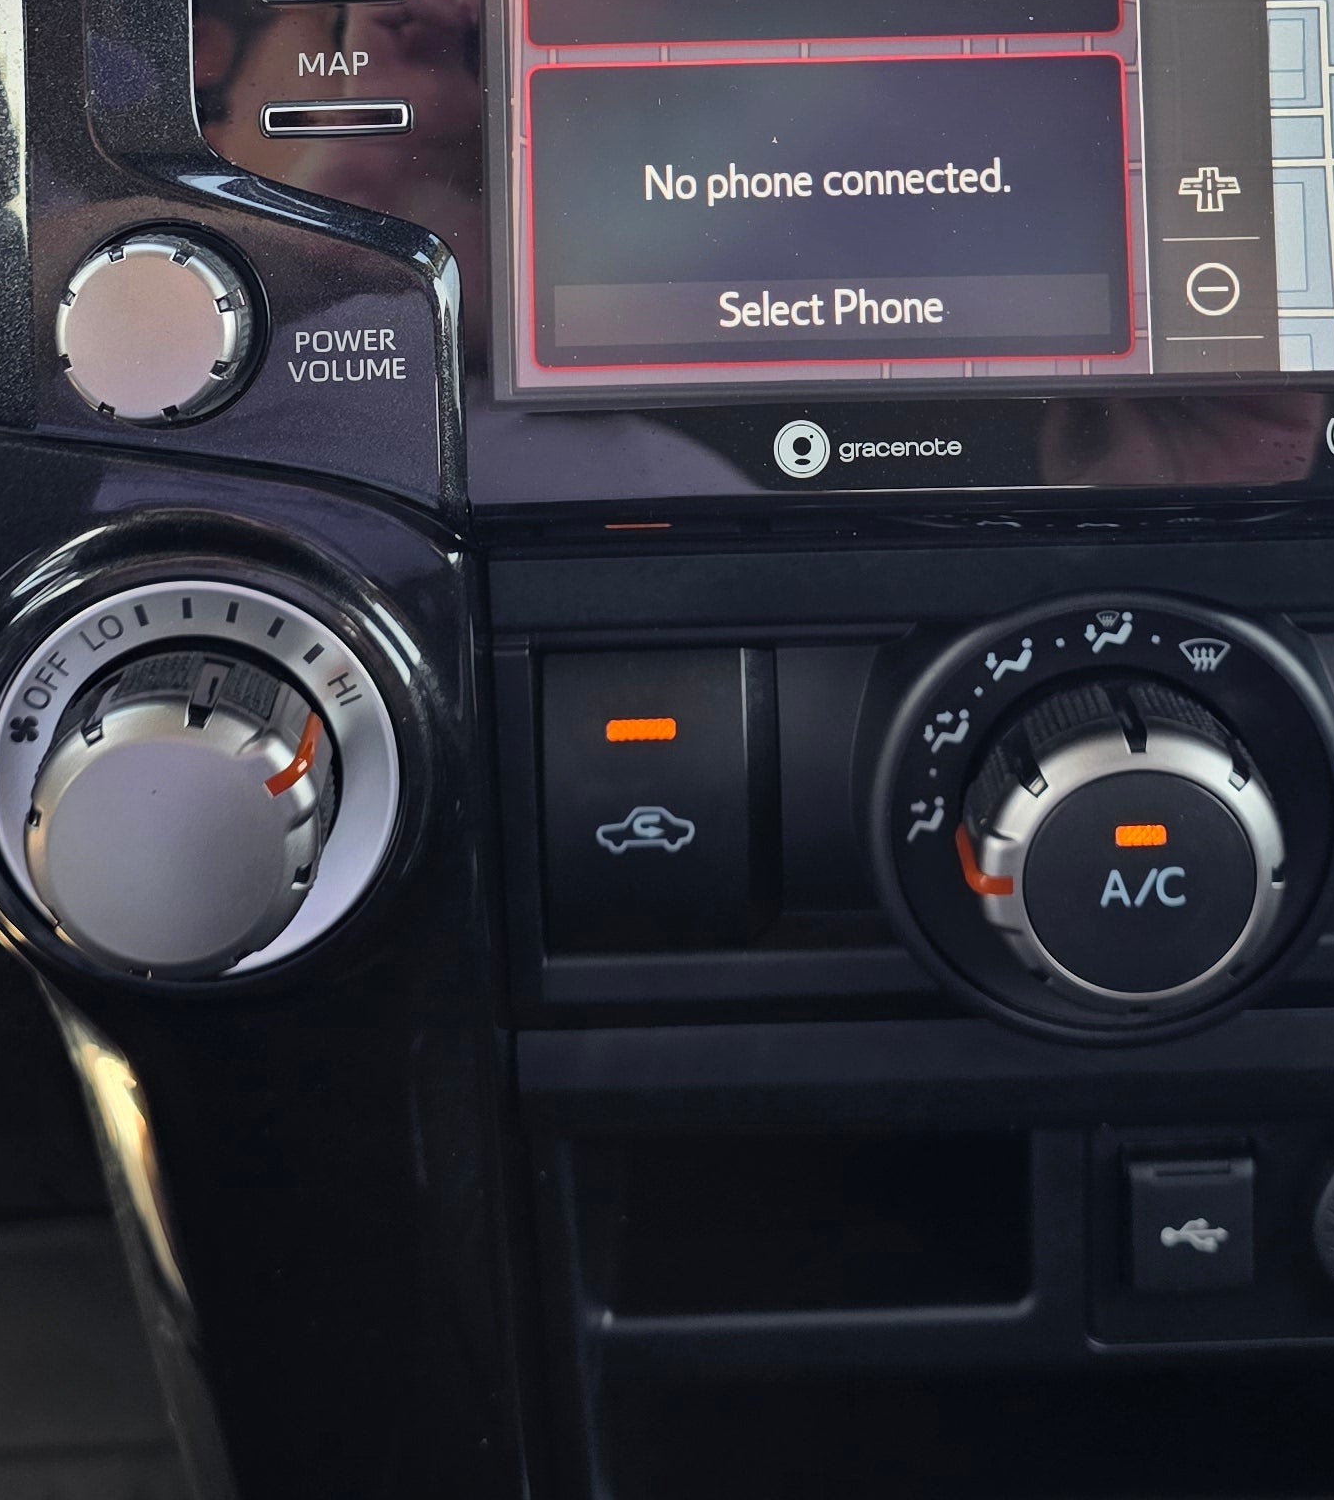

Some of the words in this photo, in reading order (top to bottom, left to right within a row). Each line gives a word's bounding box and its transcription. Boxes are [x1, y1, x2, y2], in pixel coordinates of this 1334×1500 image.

[299, 52, 368, 76] MAP
[646, 165, 696, 200] No
[708, 163, 812, 206] phone
[824, 157, 1010, 196] connected.
[720, 291, 824, 327] Select
[835, 289, 943, 324] Phone
[296, 329, 396, 353] POWER
[288, 358, 406, 382] VOLUME
[839, 438, 962, 462] gracenote
[23, 650, 71, 711] OFF
[79, 614, 124, 651] LO
[328, 672, 362, 706] HI
[1101, 867, 1185, 906] A/C
